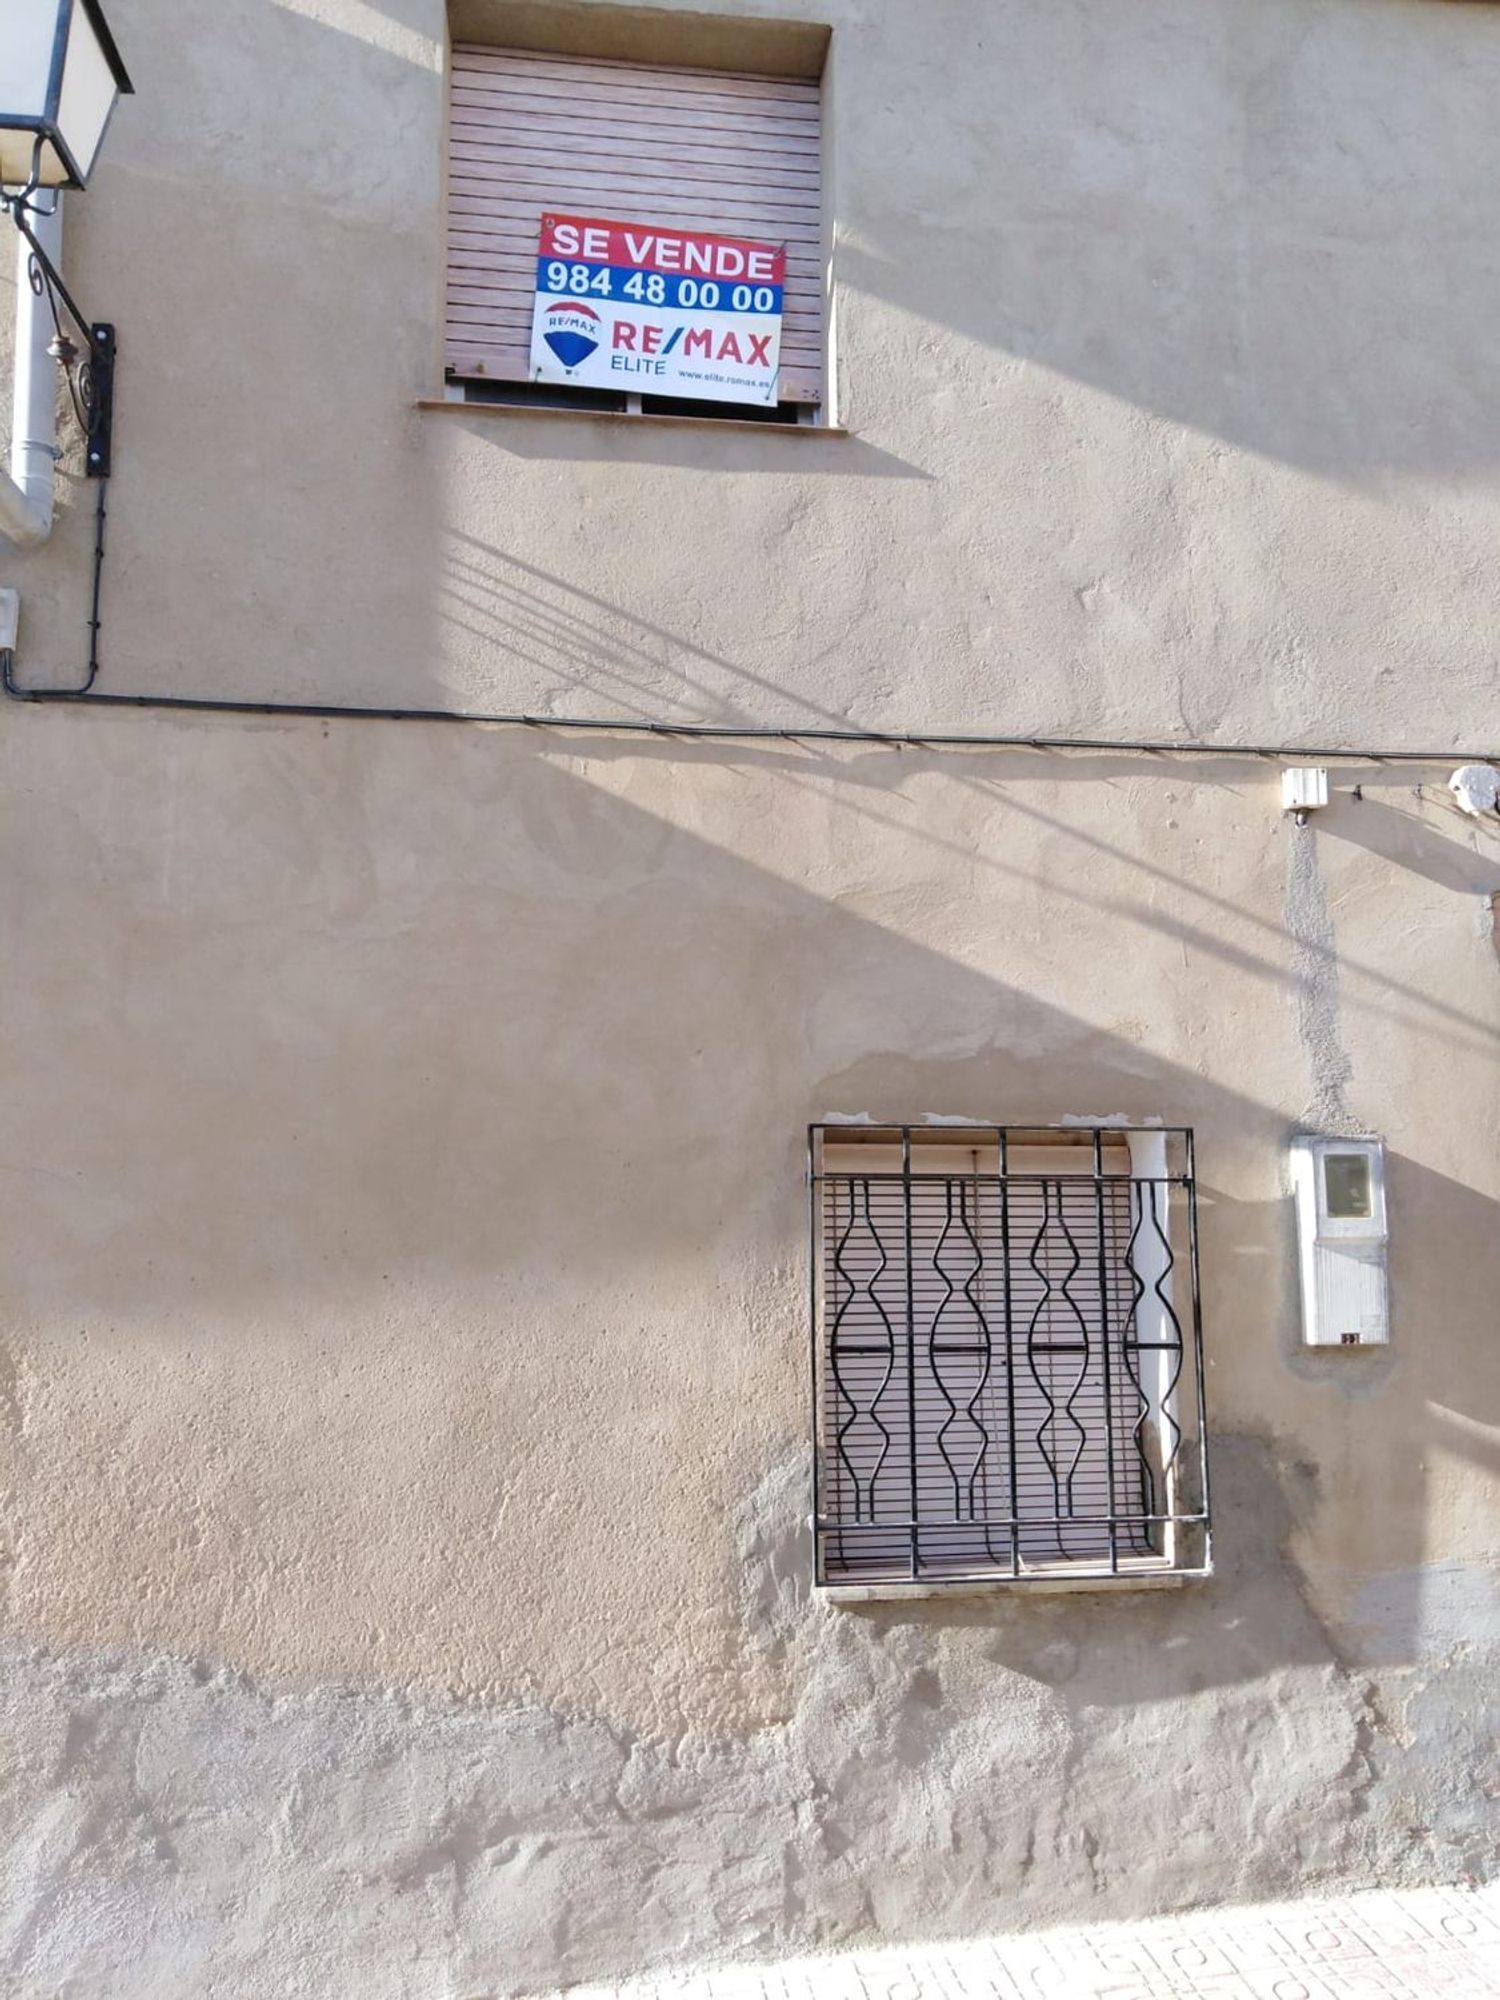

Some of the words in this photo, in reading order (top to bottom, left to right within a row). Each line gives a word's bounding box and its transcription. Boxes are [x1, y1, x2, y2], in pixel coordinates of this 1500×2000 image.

[552, 224, 610, 259] SE
[624, 233, 774, 280] VENDE
[547, 262, 612, 295] 984
[623, 272, 666, 304] 48
[678, 280, 719, 308] 00
[732, 286, 773, 311] 00
[549, 317, 596, 334] RE/MAX
[612, 320, 772, 367] RE/MAX
[611, 355, 666, 375] ELITE
